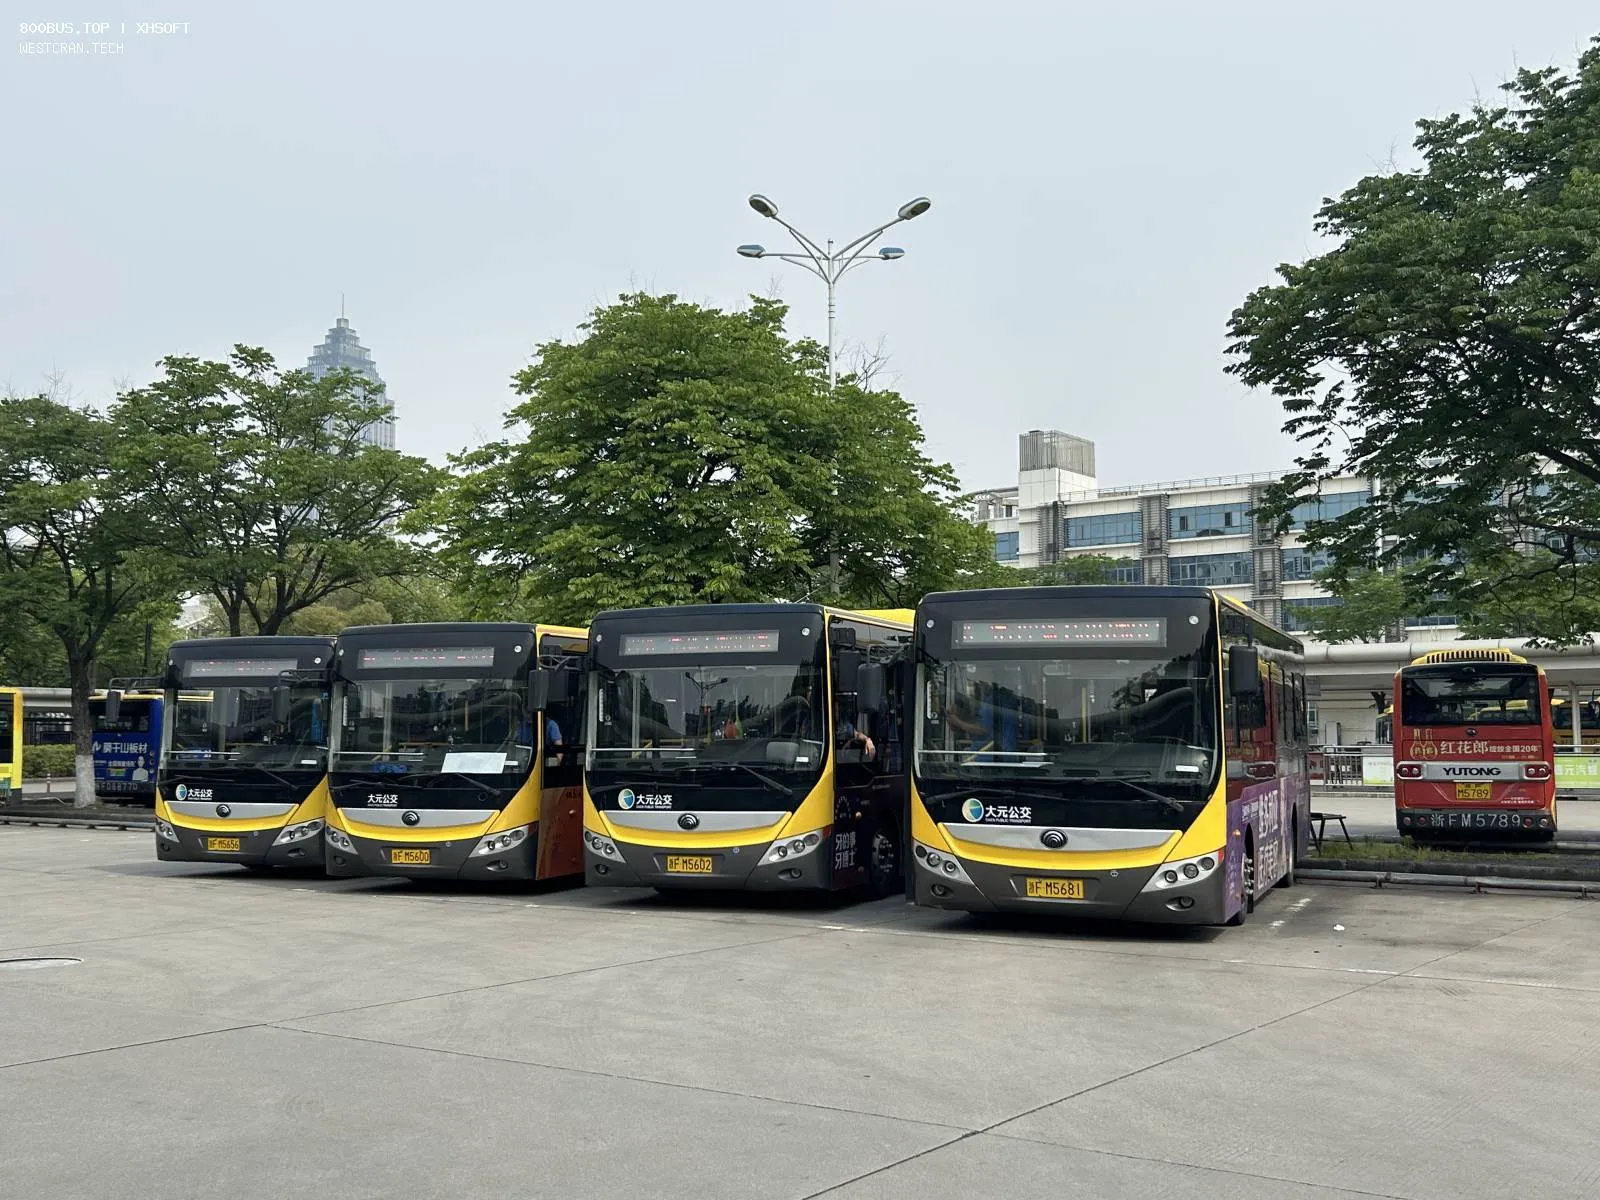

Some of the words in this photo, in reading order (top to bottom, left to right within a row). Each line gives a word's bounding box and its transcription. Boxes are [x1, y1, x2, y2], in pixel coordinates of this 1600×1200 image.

[1440, 740, 1488, 754] 红花郎
[1442, 767, 1502, 776] YUTONG
[187, 788, 213, 798] 大元公交
[367, 793, 399, 804] 大元公交
[1457, 788, 1489, 798] M5789
[635, 794, 673, 805] 大元公交
[984, 804, 1032, 819] 大元公交
[1431, 813, 1521, 828] 浙FM5789
